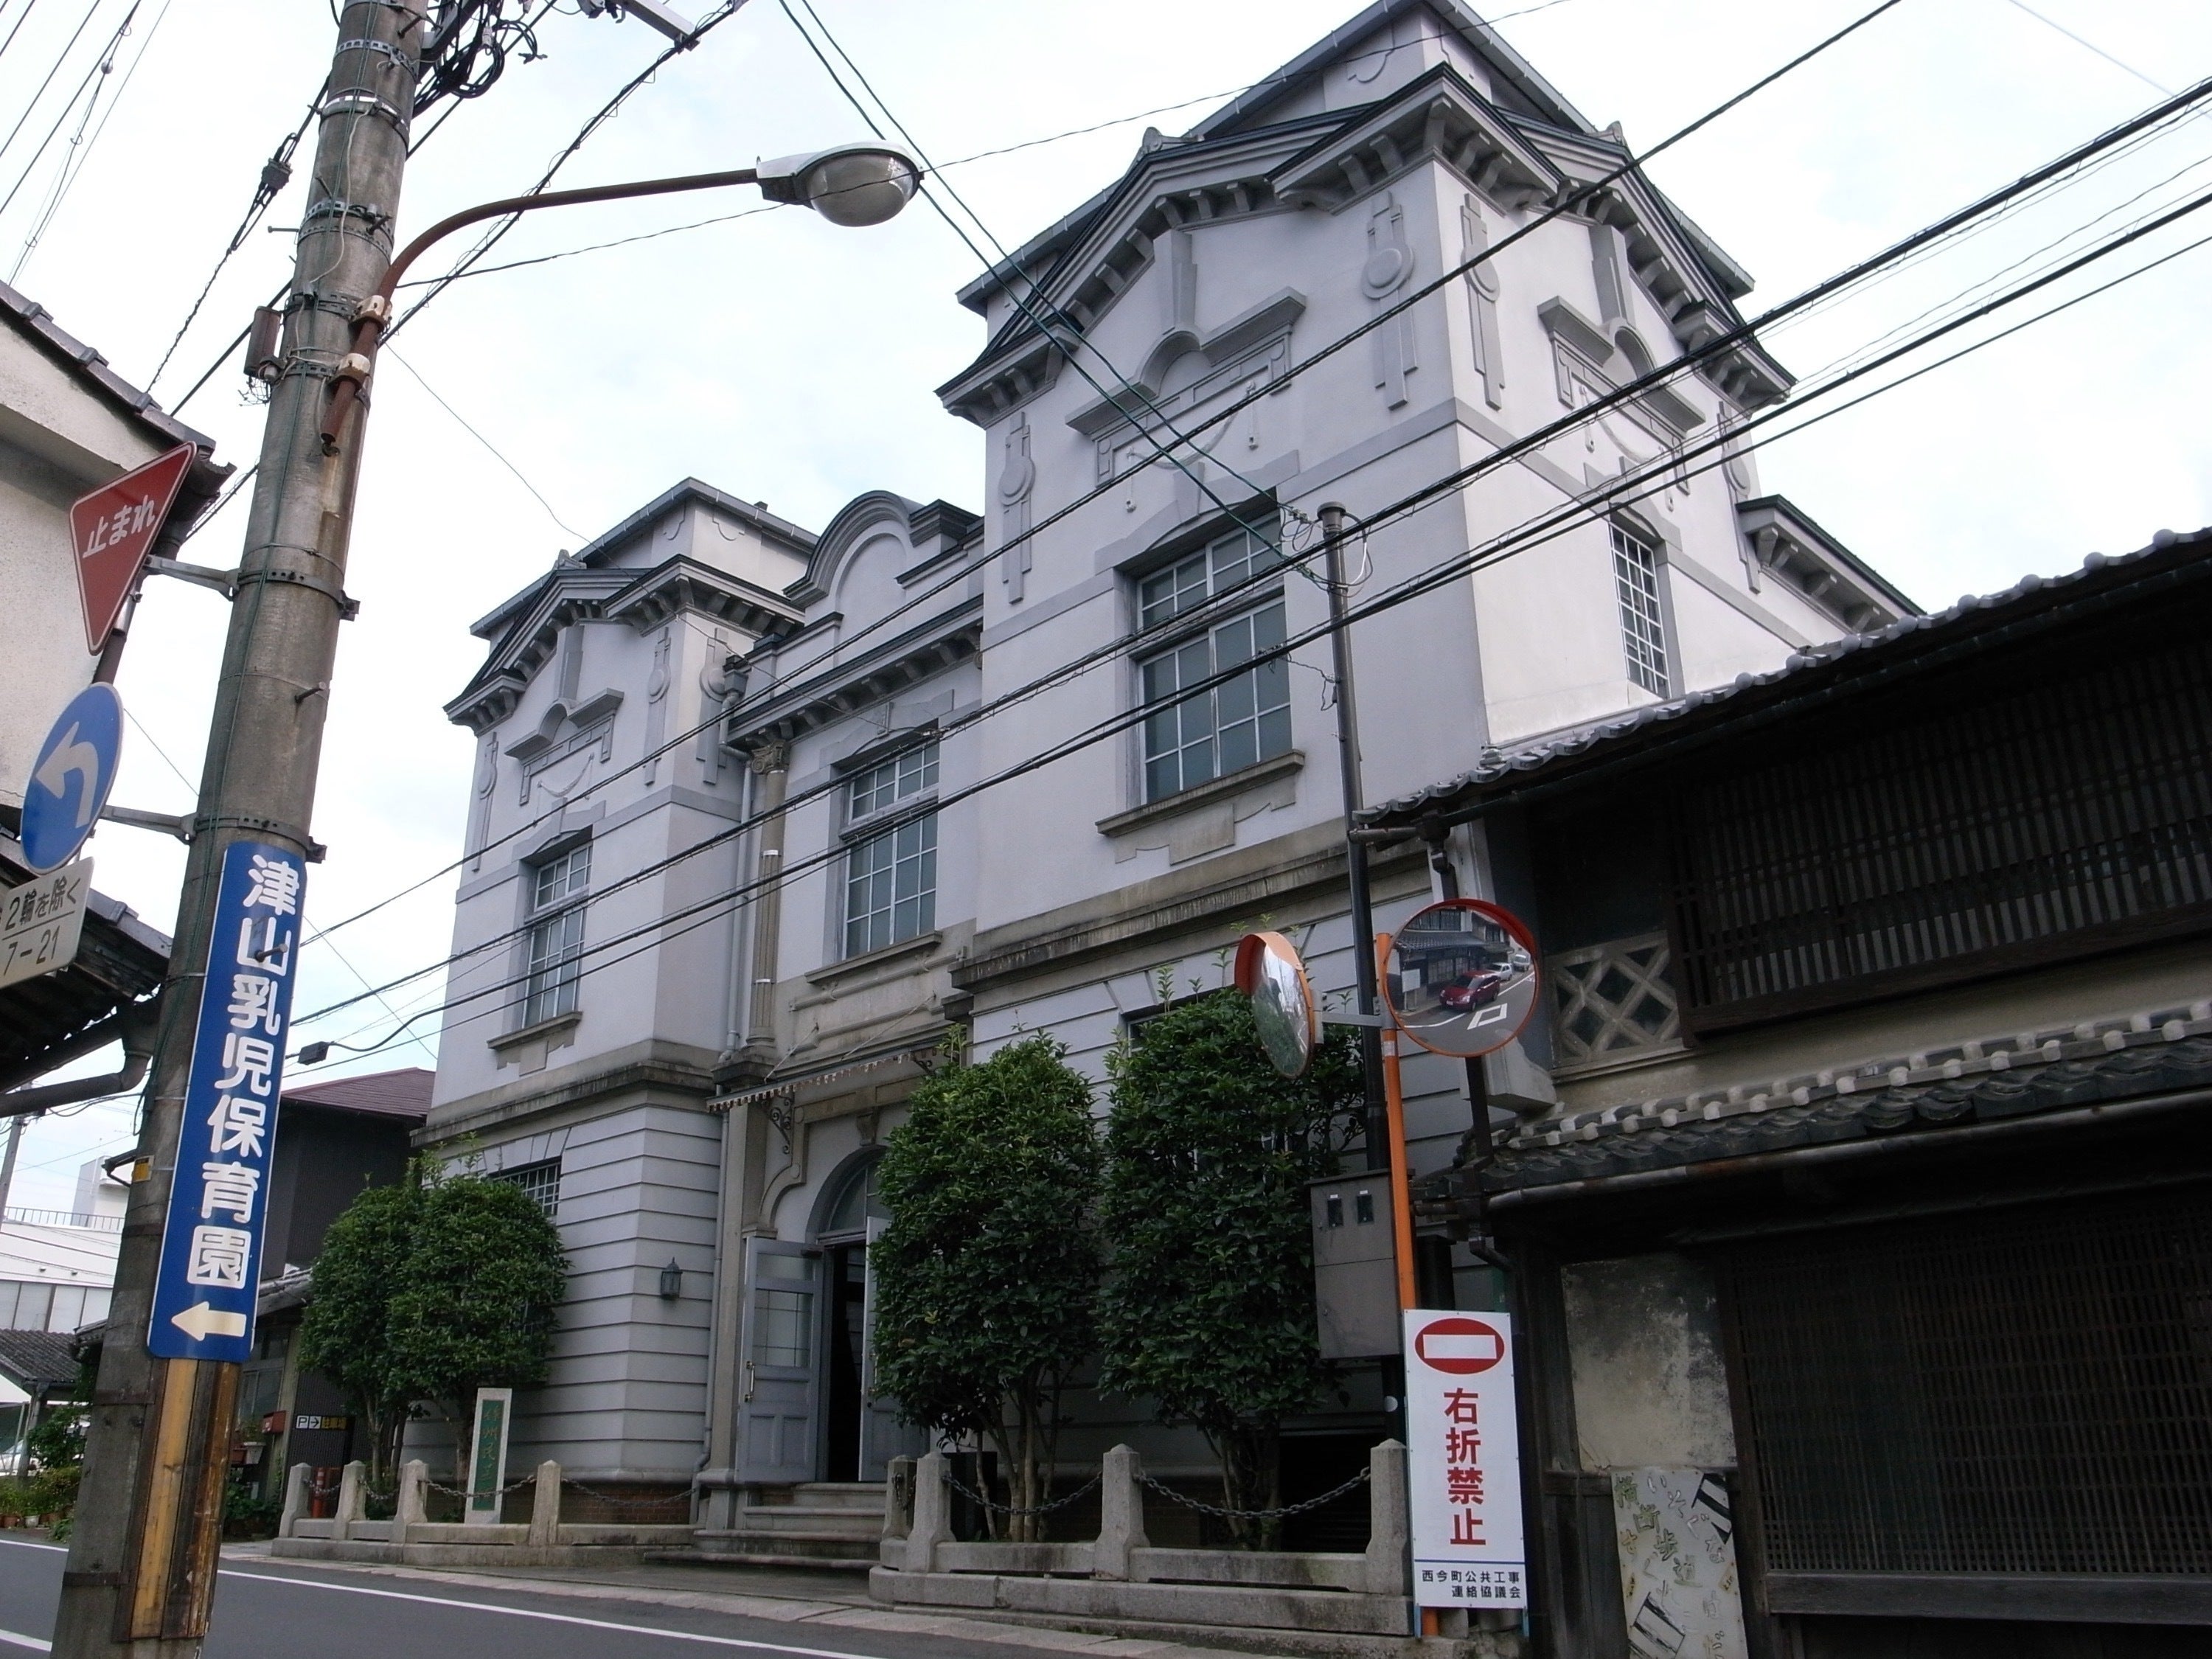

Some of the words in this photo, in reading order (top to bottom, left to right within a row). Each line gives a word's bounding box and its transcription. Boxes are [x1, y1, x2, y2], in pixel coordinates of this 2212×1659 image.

[83, 495, 156, 558] 止まれ
[5, 876, 81, 931] 2輪を除く
[187, 854, 299, 1288] 津山乳児保育園
[1444, 1388, 1486, 1545] 右折禁止
[1422, 1570, 1520, 1584] 西今町公共工事
[1451, 1586, 1521, 1599] 連絡協議会
